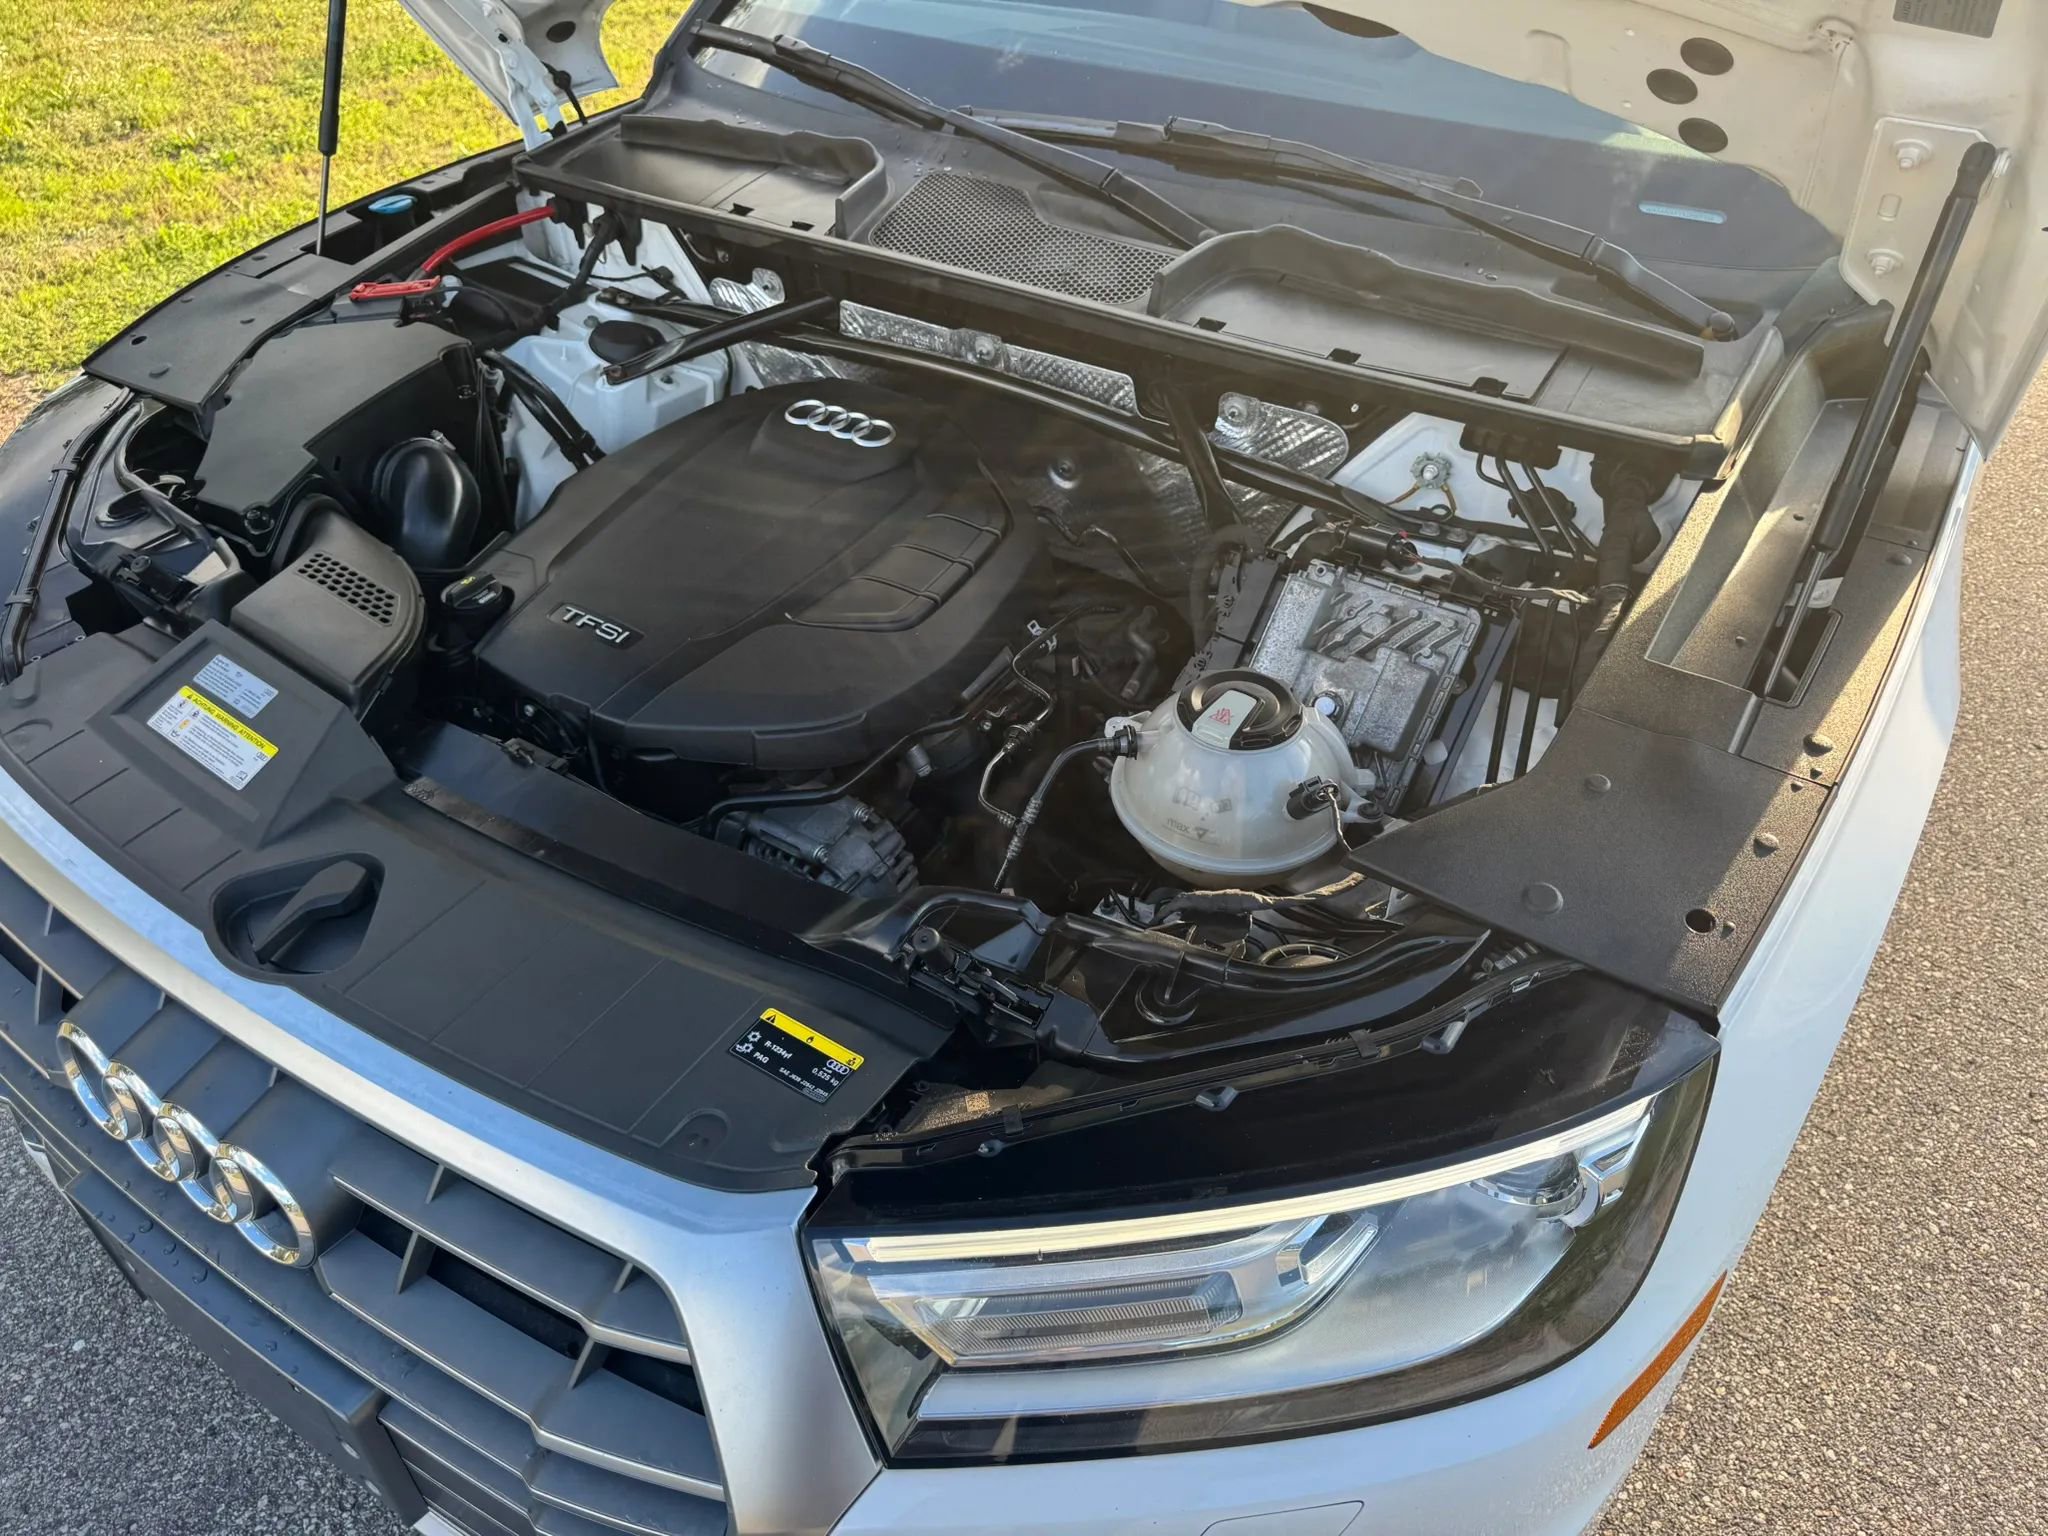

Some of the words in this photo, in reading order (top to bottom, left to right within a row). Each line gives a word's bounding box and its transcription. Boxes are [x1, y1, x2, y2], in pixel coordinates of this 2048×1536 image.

[562, 606, 631, 644] TFSI
[192, 697, 215, 715] ACHTUNG
[215, 711, 239, 730] WARNING
[238, 729, 266, 749] ATTENTION
[1167, 817, 1190, 834] max
[753, 1051, 770, 1064] PAG
[764, 1040, 793, 1060] R-1234yf
[830, 1077, 840, 1087] kg
